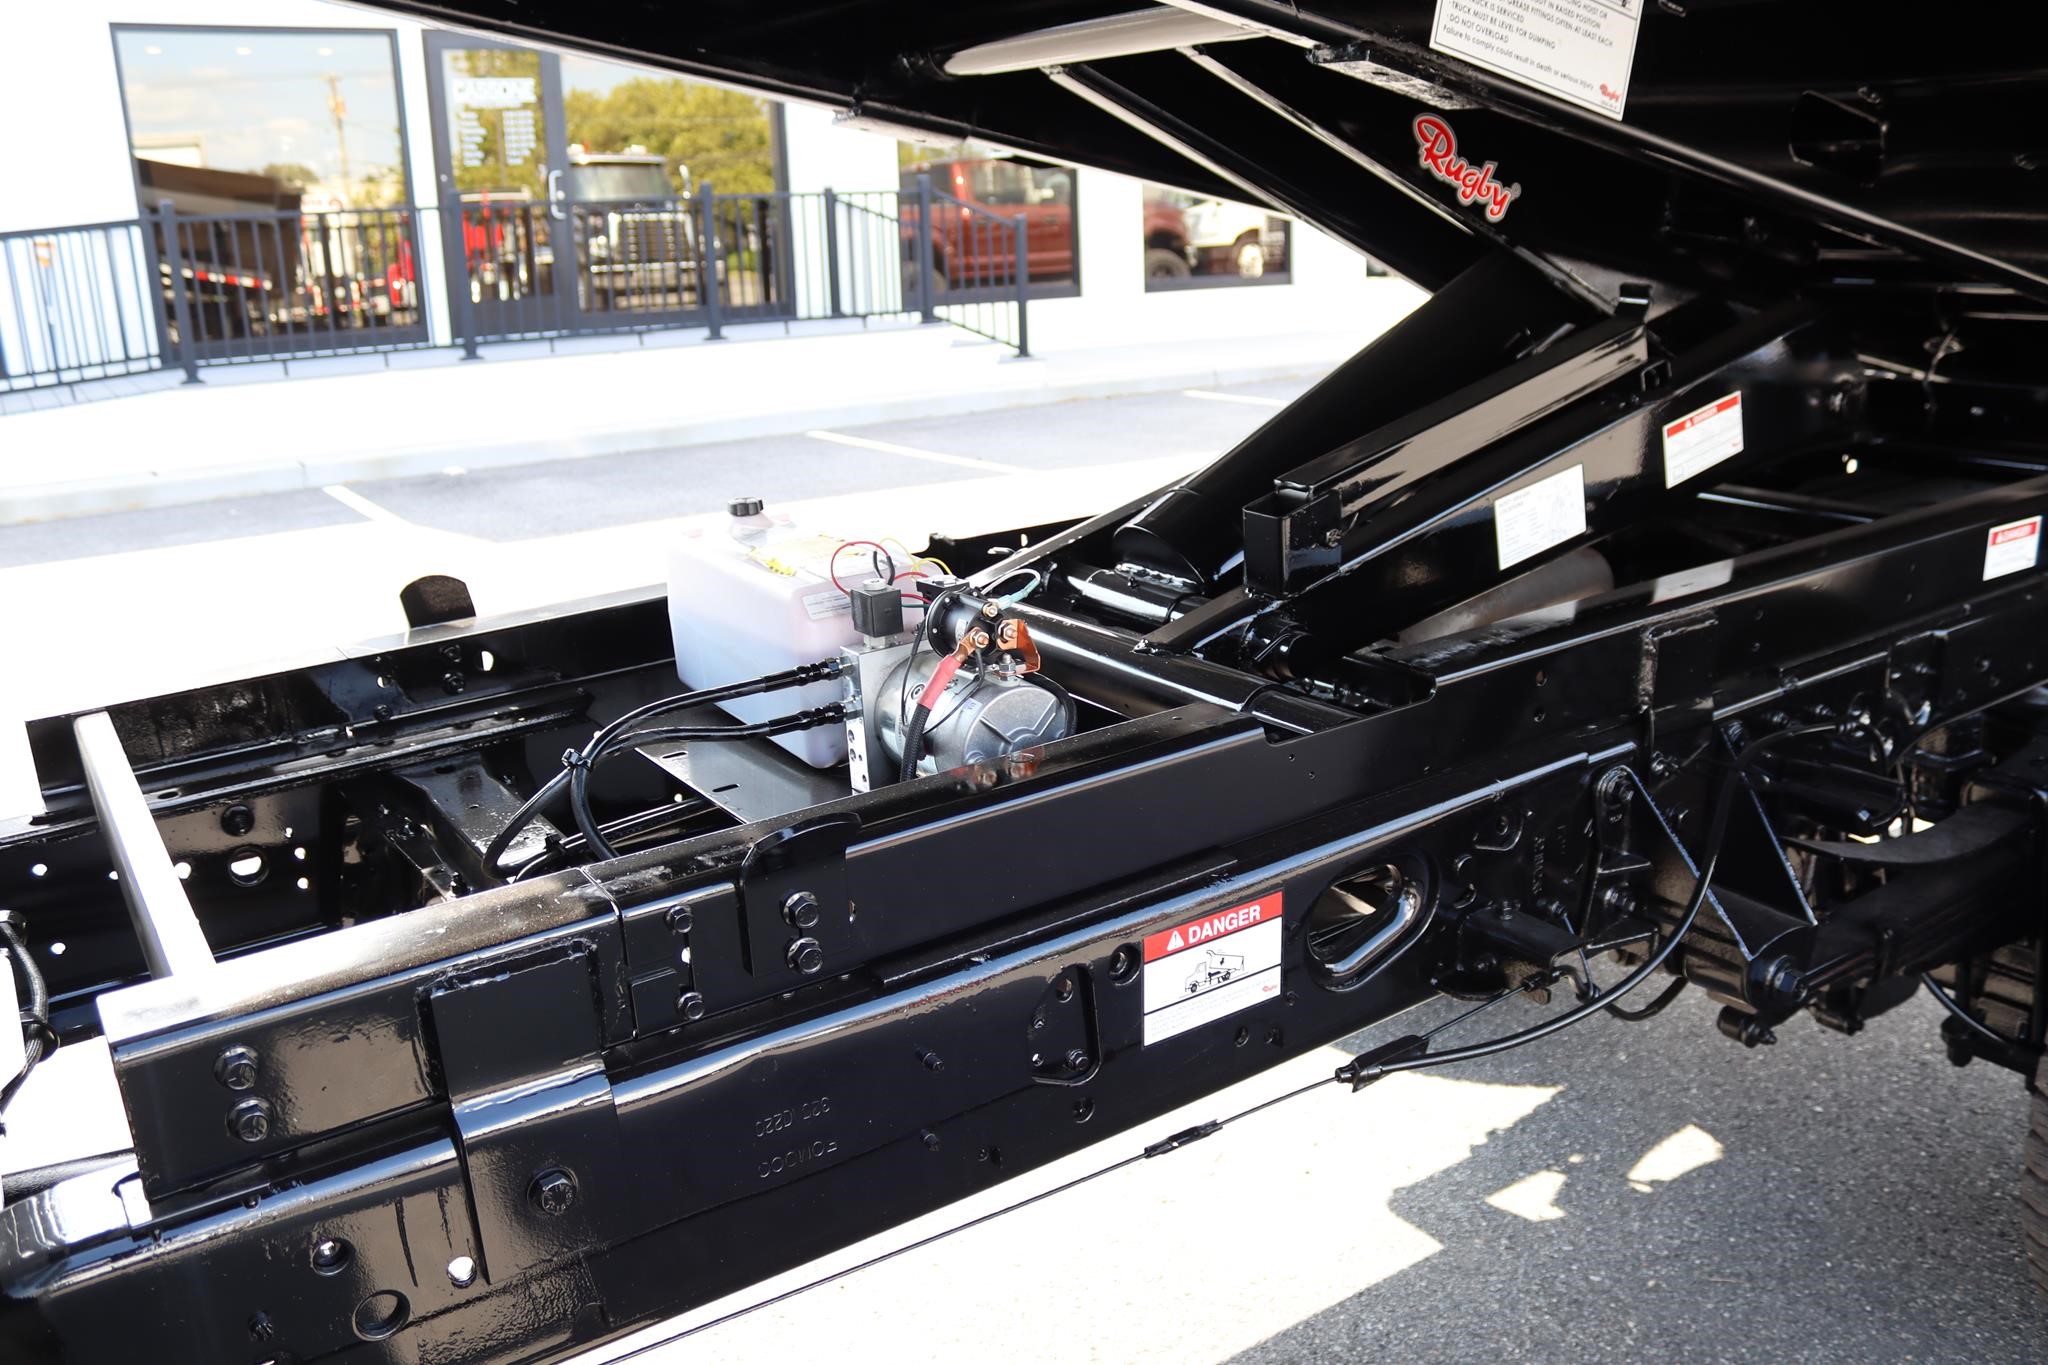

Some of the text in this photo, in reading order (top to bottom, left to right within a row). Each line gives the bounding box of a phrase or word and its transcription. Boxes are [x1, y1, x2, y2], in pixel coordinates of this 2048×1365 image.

[1449, 14, 1509, 43] DO NOT OVERLOAD
[1452, 1, 1471, 14] TRUCK
[1473, 10, 1489, 22] MUST
[1498, 19, 1514, 32] LEVEL
[1516, 26, 1527, 37] FOR
[1528, 32, 1556, 49] DUMPING
[1497, 5, 1524, 23] SERVICED
[1531, 7, 1554, 23] FITTINGS
[1582, 28, 1597, 41] LEAST
[1598, 35, 1613, 47] EACH
[1556, 5, 1575, 18] RAISED
[1576, 13, 1601, 29] POSITION
[1443, 24, 1463, 39] Failure
[1472, 36, 1494, 51] comply
[1496, 46, 1513, 58] could
[1514, 52, 1530, 63] result
[1536, 61, 1552, 73] death
[1560, 72, 1579, 85] serious
[1414, 113, 1513, 221] Rugby
[1188, 904, 1261, 944] DANGER
